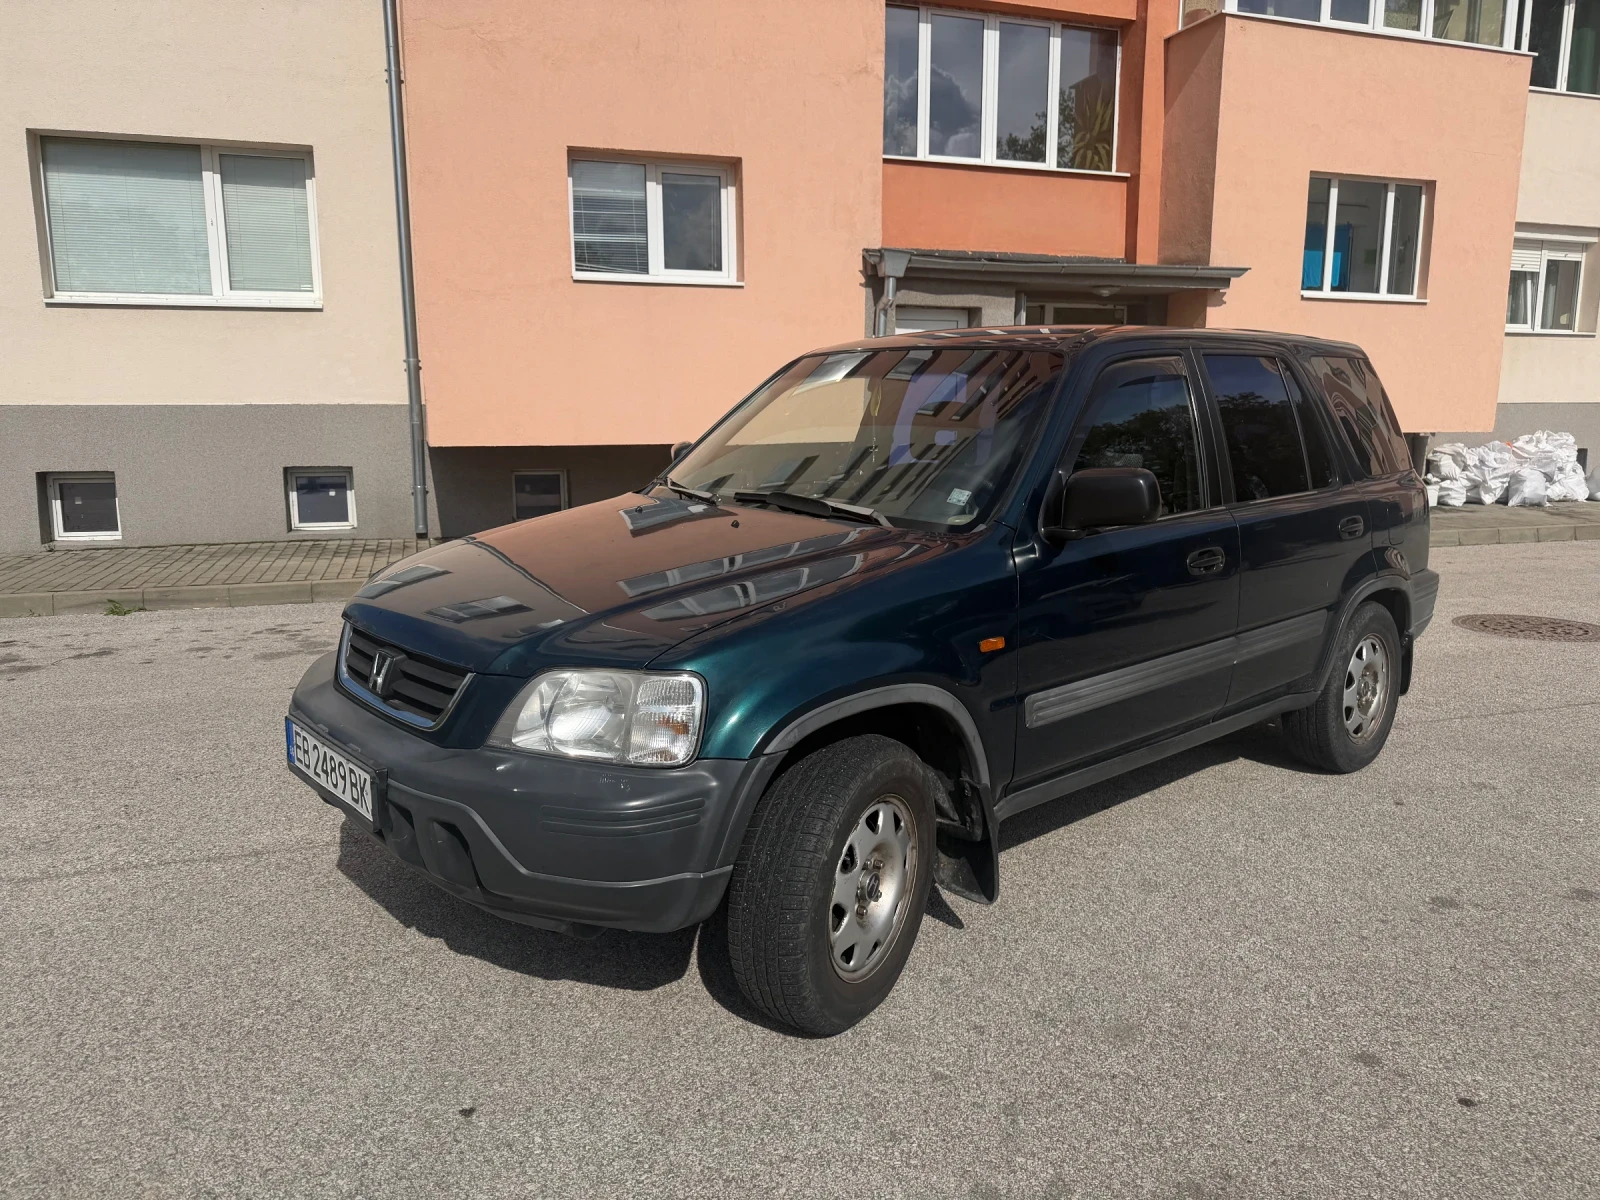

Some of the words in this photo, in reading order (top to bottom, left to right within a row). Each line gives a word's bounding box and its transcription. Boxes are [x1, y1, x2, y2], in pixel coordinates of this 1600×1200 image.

[295, 730, 310, 770] EB
[312, 743, 346, 794] 2489
[349, 767, 370, 813] BK
